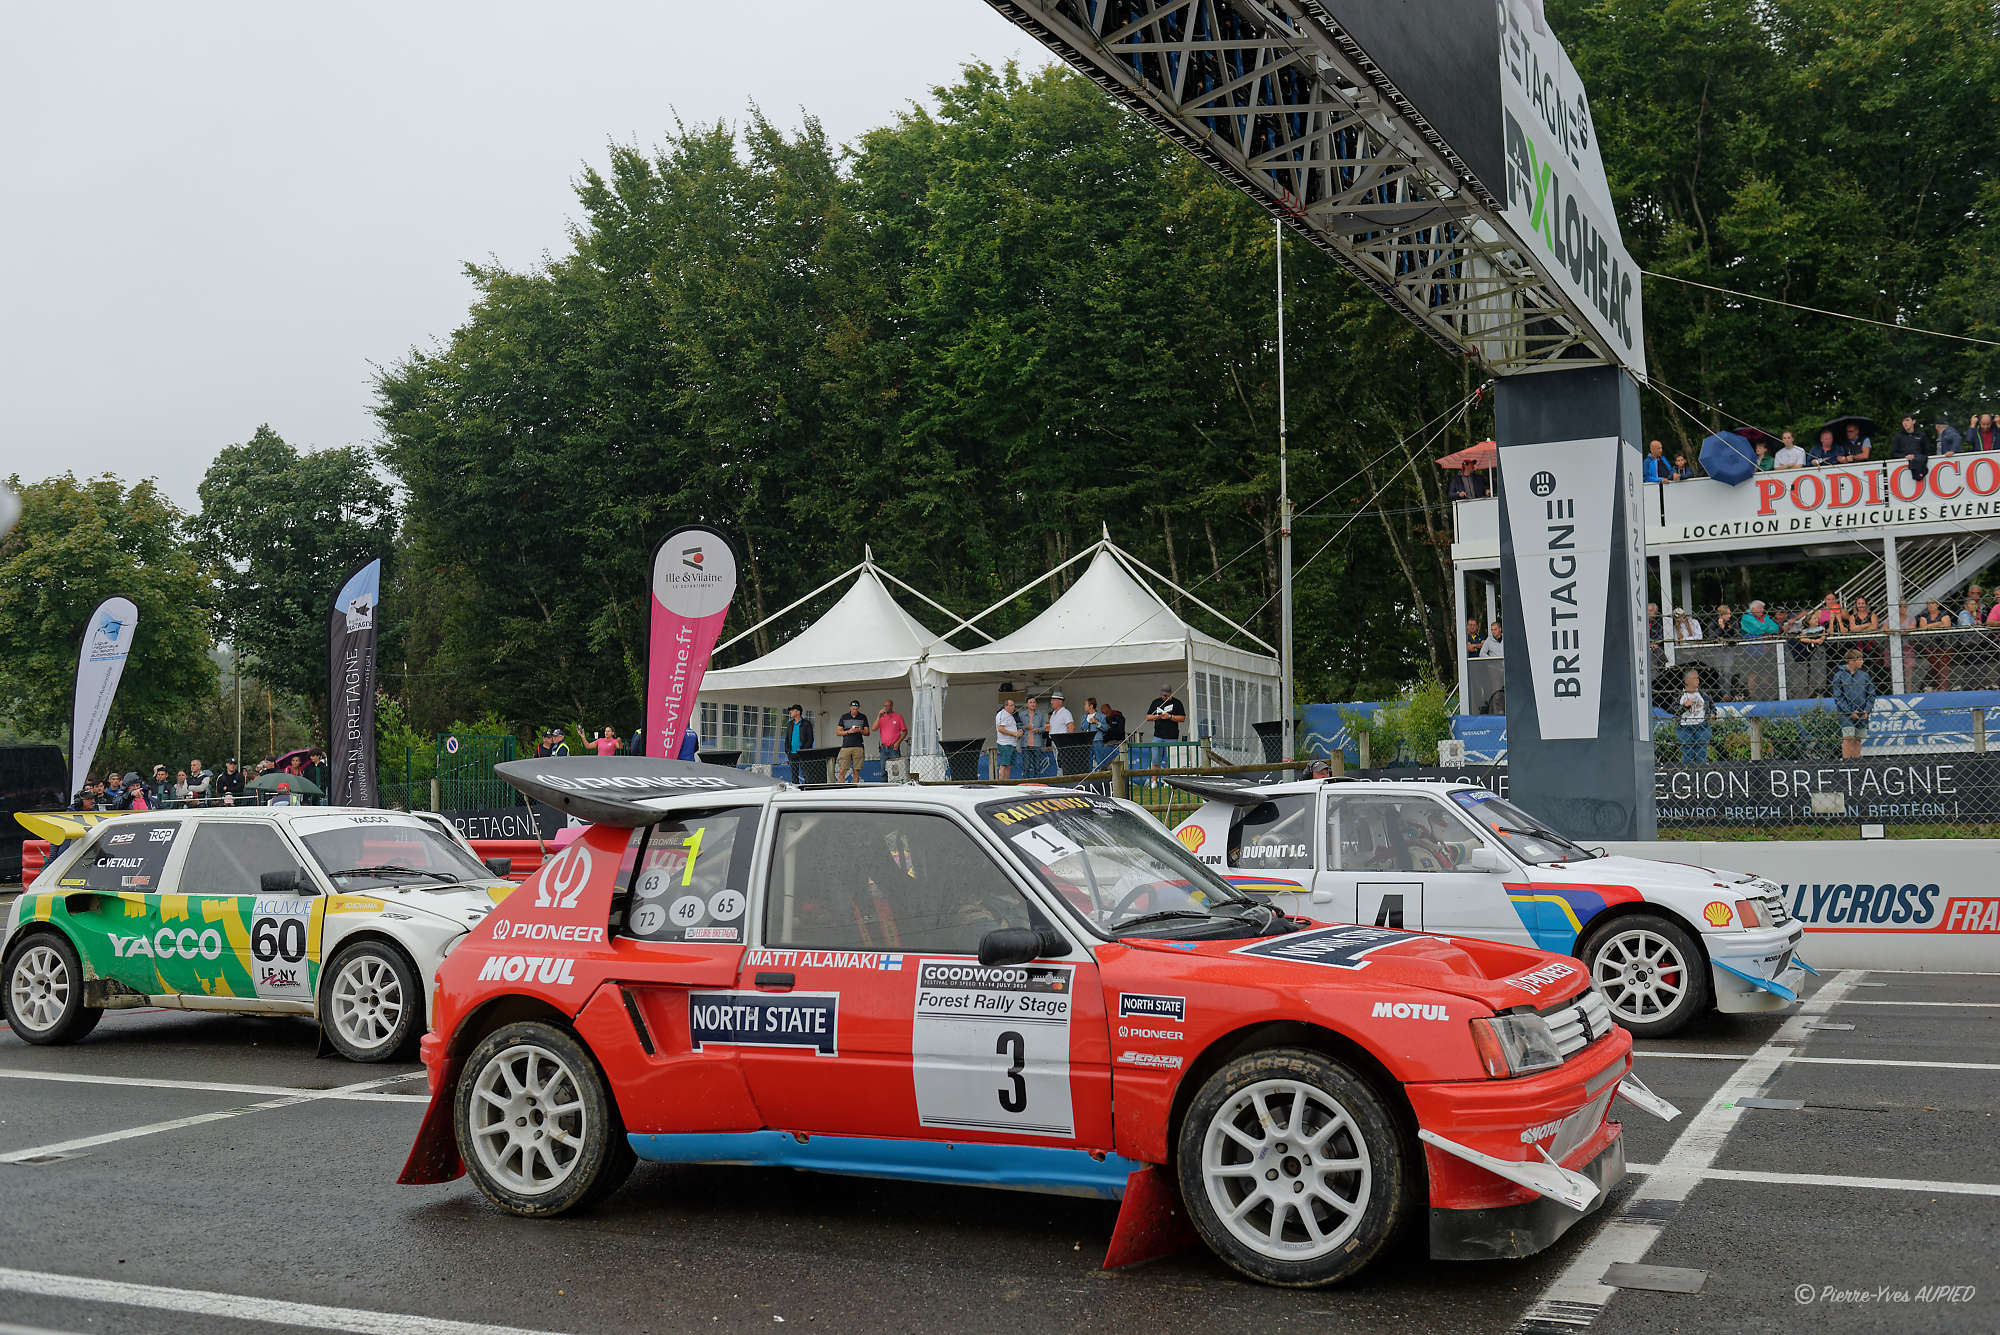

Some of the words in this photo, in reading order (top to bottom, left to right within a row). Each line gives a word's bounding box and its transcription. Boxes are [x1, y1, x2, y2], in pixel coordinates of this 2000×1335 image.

[1498, 2, 1580, 172] RETAGNE
[1552, 171, 1633, 351] LOHEAC
[1683, 519, 1779, 539] LOCATION
[1790, 516, 1812, 530] DE
[1822, 507, 1928, 528] VÉHICULES
[1547, 498, 1581, 698] BRETAGNE
[1632, 503, 1645, 698] BRETAGNE
[345, 648, 361, 741] BRETAGNE
[1868, 719, 1926, 732] OHEAC
[575, 776, 739, 790] PIONEER
[1655, 762, 1749, 799] ÉGION
[1770, 766, 1956, 798] BRETAGNE
[348, 816, 389, 824] YACCO
[993, 797, 1091, 826] RALLYCROSS
[1724, 806, 1781, 819] BREIZH
[455, 813, 542, 840] RETAGNE
[1031, 830, 1065, 853] 1
[1242, 844, 1288, 859] DUPONT
[1289, 844, 1308, 858] J.C.
[97, 857, 145, 868] C.VETAULT
[681, 827, 705, 886] 1
[644, 876, 660, 890] 63
[255, 900, 313, 914] ACUVUE
[678, 903, 696, 918] 48
[717, 898, 735, 913] 65
[1781, 884, 1940, 924] LYCROSS
[1946, 901, 2000, 930] FRA
[640, 911, 655, 927] 72
[107, 927, 222, 960] YACCO
[251, 917, 306, 963] 60
[511, 923, 603, 942] PIONEER
[478, 955, 576, 985] MOTUL
[747, 951, 797, 967] MATTI
[800, 952, 878, 969] ALAMAKI
[925, 967, 1028, 983] GOODWOOD
[918, 992, 970, 1008] Forest
[973, 994, 1015, 1014] Rally
[1019, 996, 1068, 1015] Stage
[1124, 998, 1154, 1010] NORTH
[1156, 1000, 1181, 1012] STATE
[1371, 1002, 1450, 1021] MOTUL
[693, 1005, 760, 1031] NORTH
[765, 1006, 827, 1033] STATE
[1130, 1028, 1184, 1040] PIONEER
[995, 1030, 1027, 1113] 3
